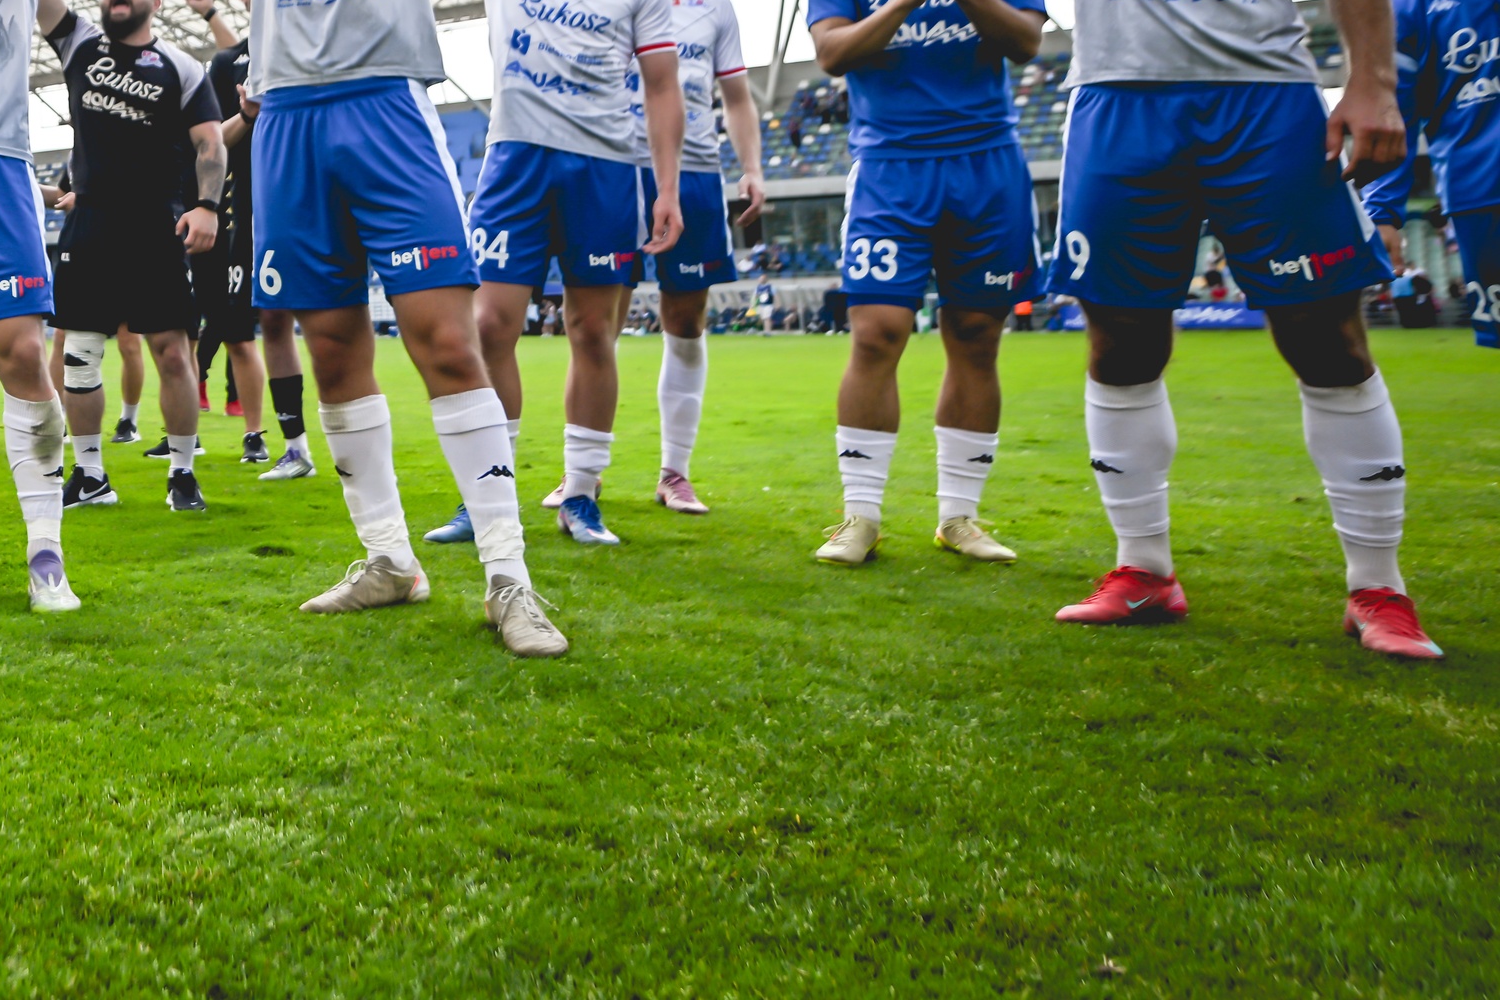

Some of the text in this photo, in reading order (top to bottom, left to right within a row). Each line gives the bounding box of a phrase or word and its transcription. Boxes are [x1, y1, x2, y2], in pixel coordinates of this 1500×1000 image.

[259, 250, 282, 296] 6
[391, 245, 458, 271] betters
[849, 237, 898, 282] 33
[1065, 230, 1091, 281] 9
[1269, 245, 1355, 281] betters
